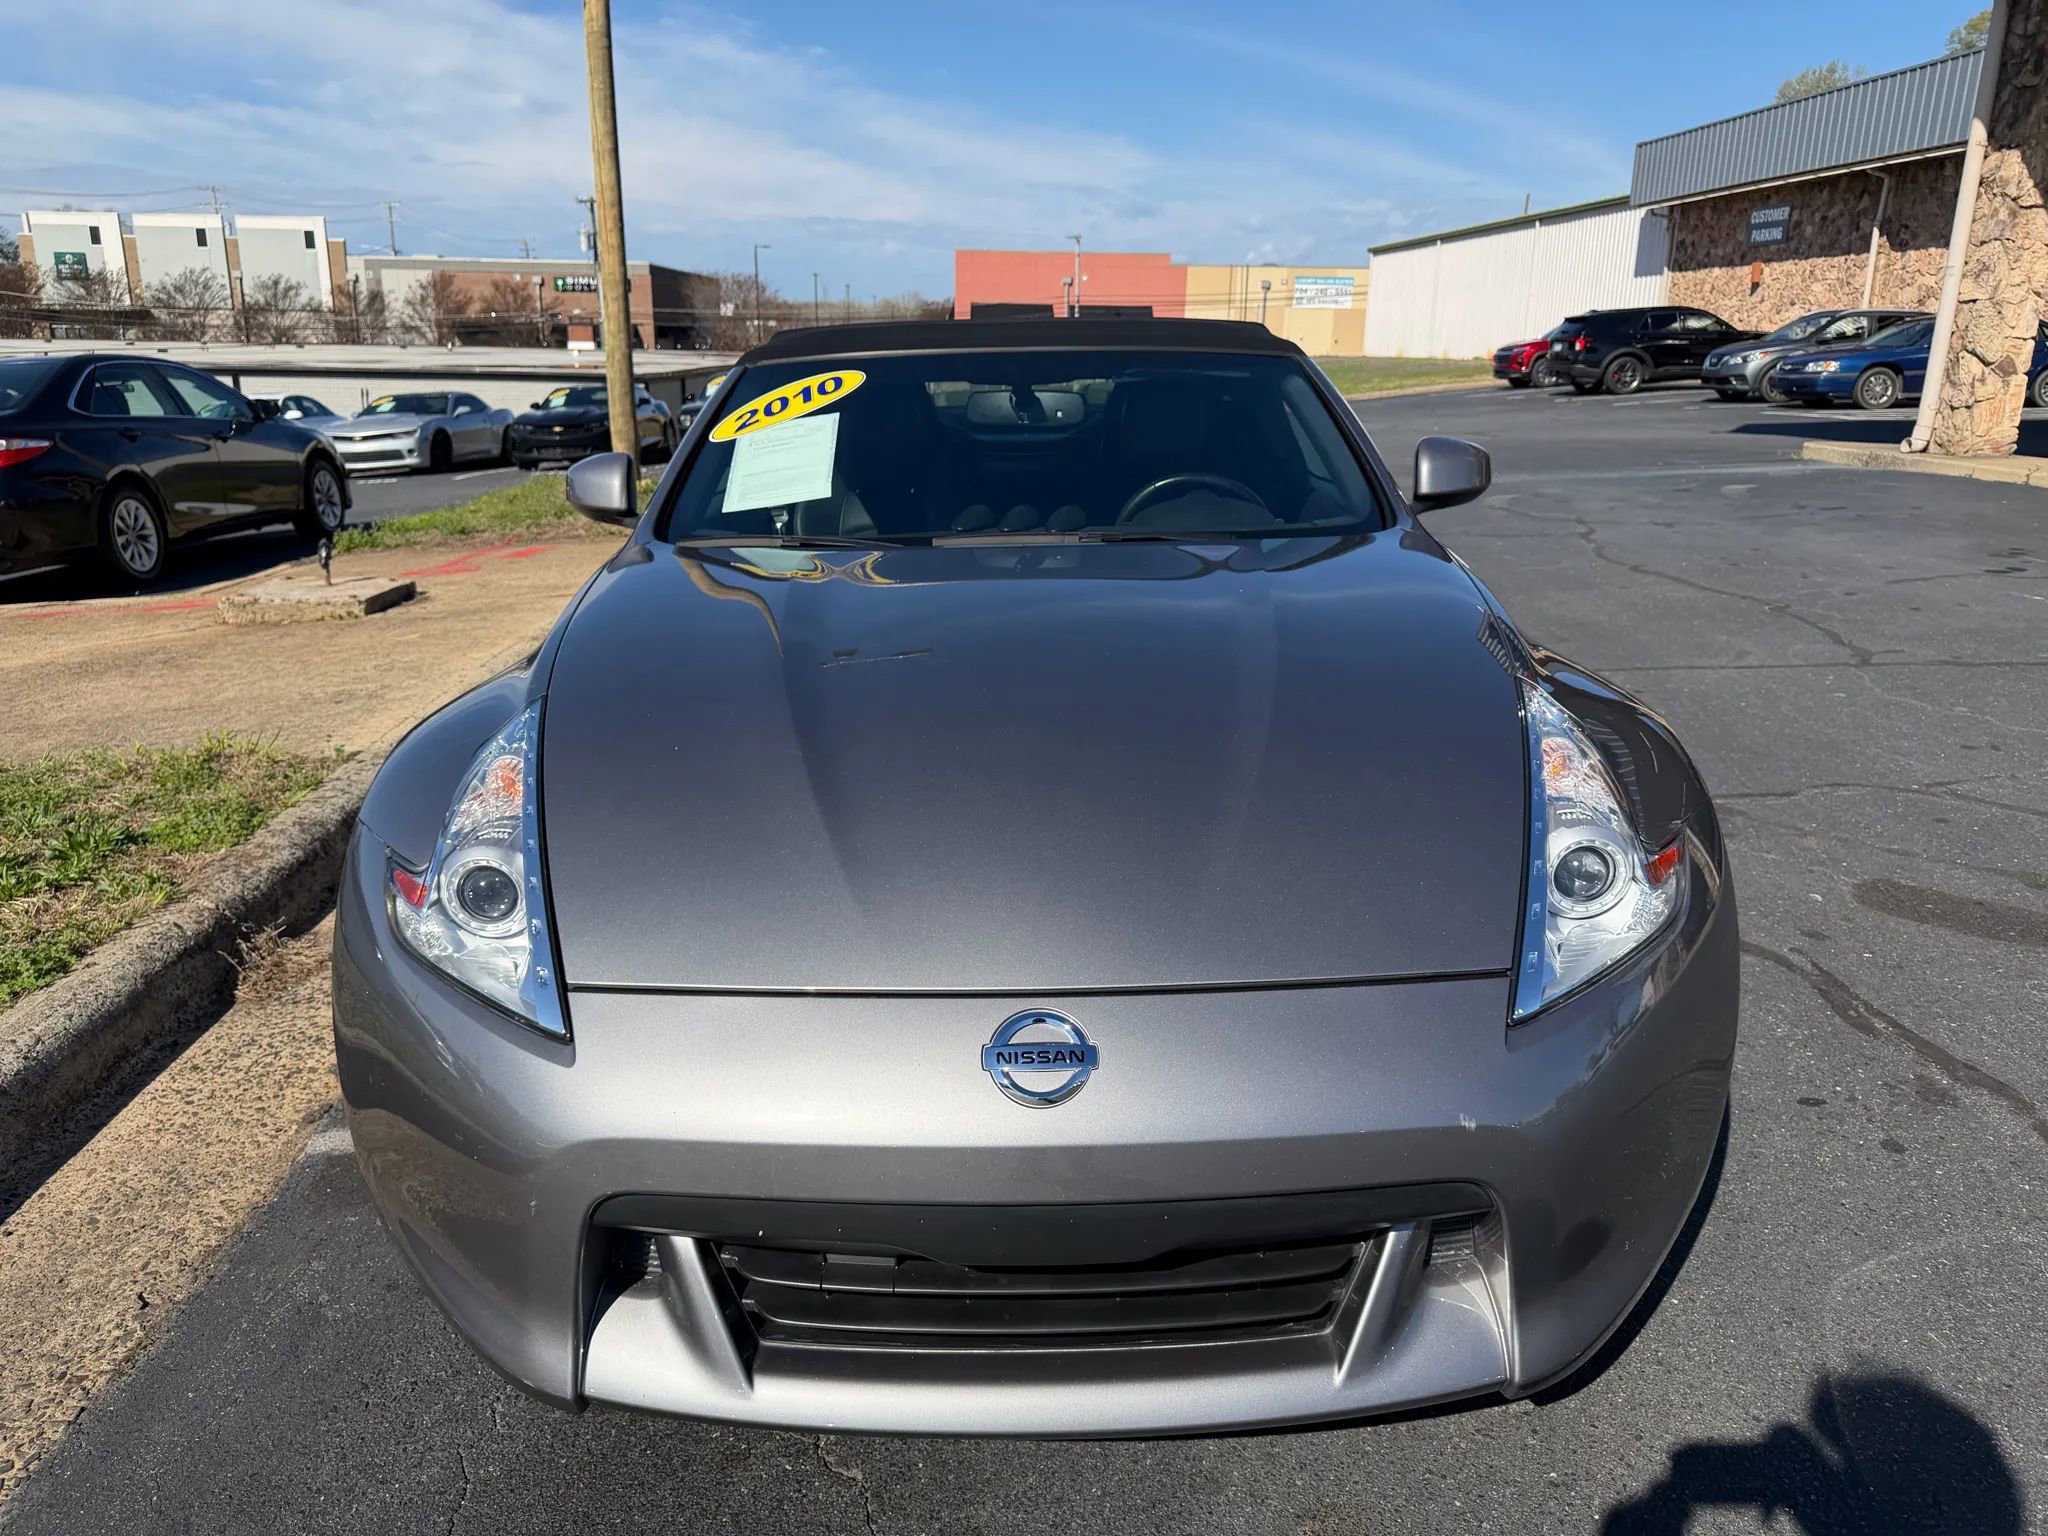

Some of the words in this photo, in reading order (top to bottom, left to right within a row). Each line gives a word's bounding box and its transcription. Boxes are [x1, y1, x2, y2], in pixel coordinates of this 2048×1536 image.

[1751, 206, 1790, 224] CUSTOMER
[1750, 226, 1783, 243] PARKING
[734, 376, 844, 434] 2010
[996, 1049, 1085, 1065] NISSAN
